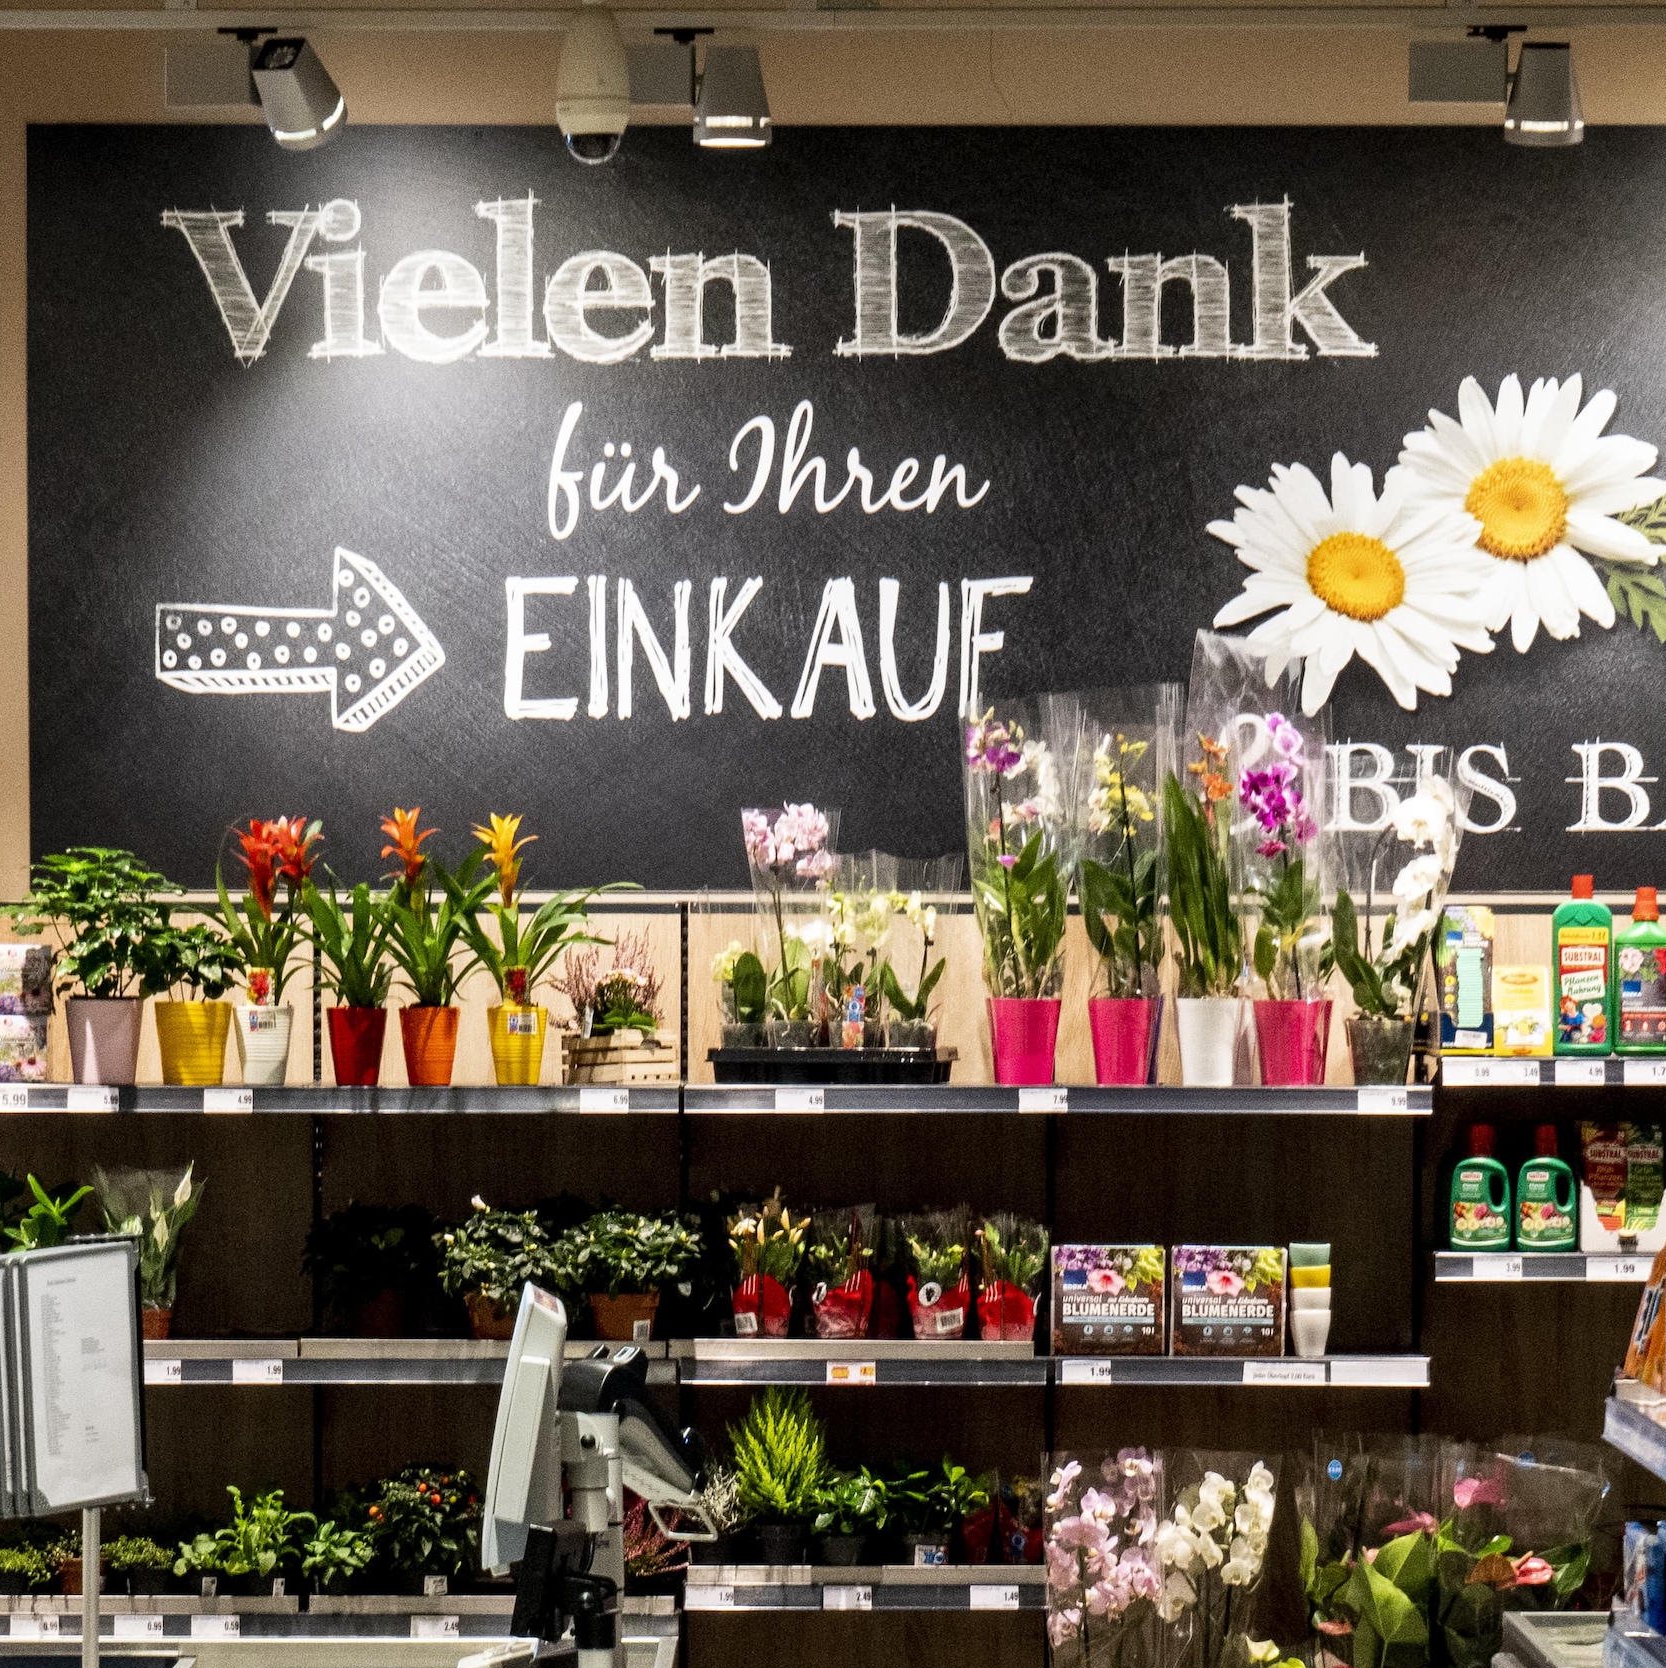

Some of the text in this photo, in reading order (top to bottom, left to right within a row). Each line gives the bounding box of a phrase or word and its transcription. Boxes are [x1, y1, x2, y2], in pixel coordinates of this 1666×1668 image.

[159, 190, 1380, 368] Vielen Dank
[547, 400, 990, 540] für Ihren
[505, 575, 1033, 724] EINKAUF
[1321, 738, 1521, 834] BIS
[1564, 950, 1602, 962] SUBSTRAL
[1567, 984, 1602, 998] Nahrung
[1588, 1067, 1603, 1077] 4.99
[2, 1094, 26, 1106] 5.99
[103, 1094, 119, 1105] 5.99
[237, 1094, 252, 1106] 4.99
[613, 1094, 629, 1106] 6.99
[808, 1094, 823, 1106] 4.99
[1053, 1094, 1068, 1106] 7.99
[1391, 1095, 1407, 1107] 9.99
[1589, 1149, 1624, 1159] SUBSTRAL
[1506, 1263, 1521, 1273] 3.99
[1614, 1263, 1635, 1274] 1.99
[1062, 1295, 1103, 1304] universal
[1181, 1295, 1223, 1304] universal
[1062, 1303, 1155, 1317] BLUMENERDE
[1181, 1303, 1275, 1317] BLUMENERDE
[166, 1365, 181, 1377] 1.99
[266, 1365, 281, 1377] 1.99
[1090, 1367, 1111, 1378] 1.99
[717, 1592, 735, 1604] 1.99
[854, 1592, 872, 1604] 2.49
[1003, 1592, 1020, 1604] 1.49
[146, 1620, 162, 1632] 0.99
[443, 1620, 459, 1632] 2.49
